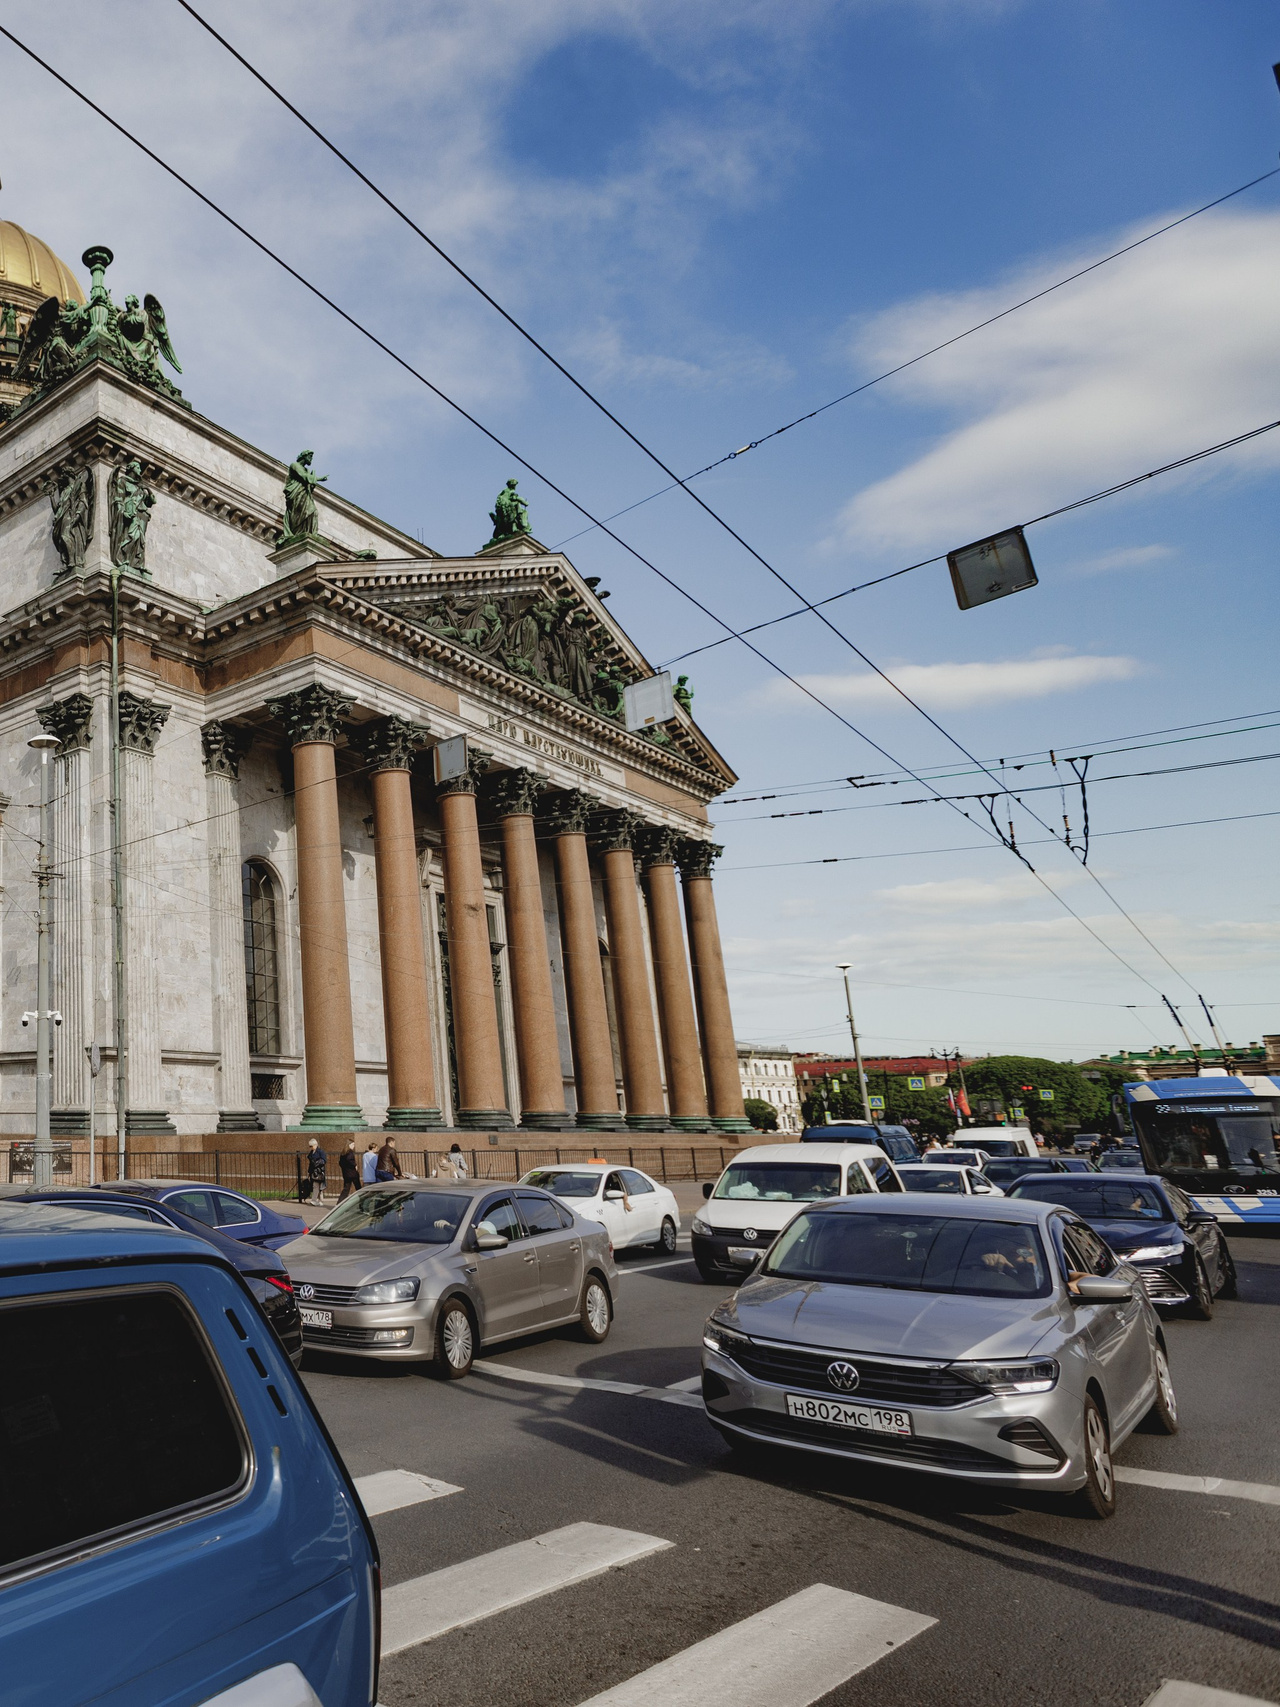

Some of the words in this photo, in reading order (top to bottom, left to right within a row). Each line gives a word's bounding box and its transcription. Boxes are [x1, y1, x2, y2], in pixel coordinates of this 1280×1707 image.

[315, 1311, 330, 1322] 178
[873, 1410, 905, 1428] 198
[881, 1424, 898, 1432] RUS
